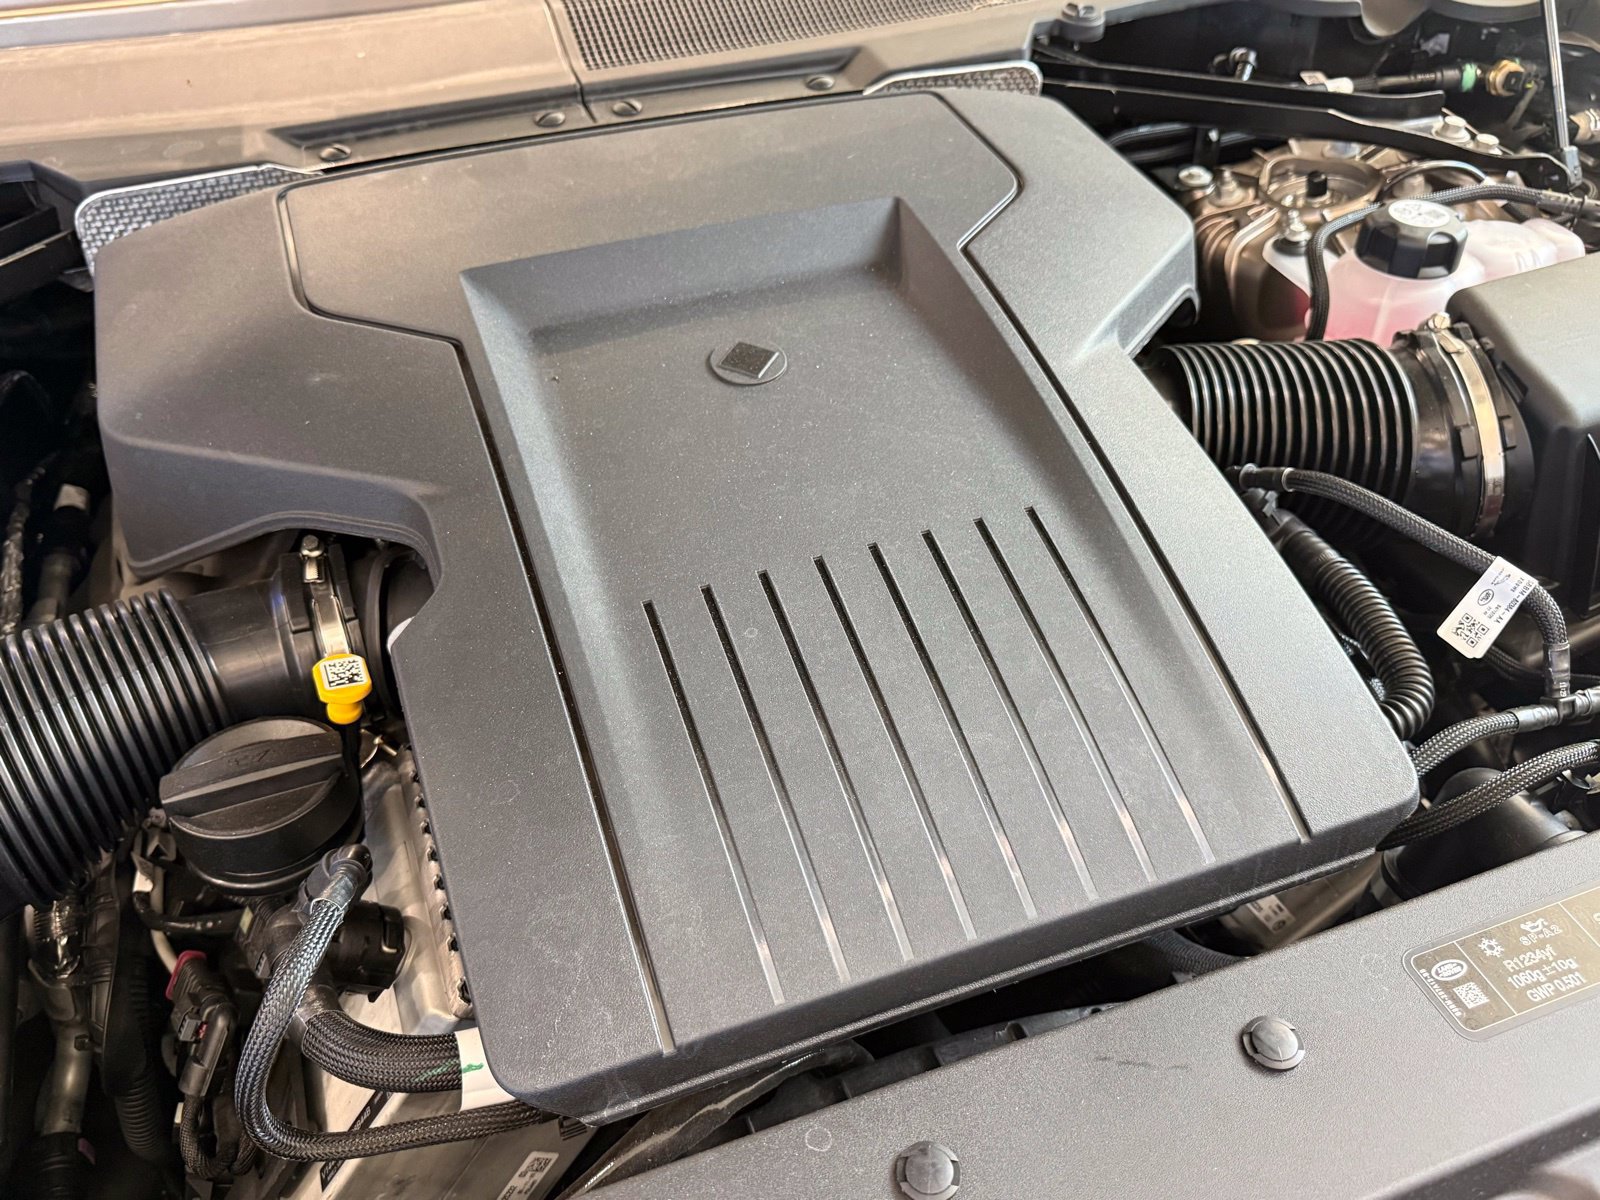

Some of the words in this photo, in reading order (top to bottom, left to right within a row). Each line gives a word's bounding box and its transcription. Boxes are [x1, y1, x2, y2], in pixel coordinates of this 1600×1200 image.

[1519, 924, 1563, 946] SP-A2
[1502, 943, 1557, 973] R1234yf
[1507, 969, 1547, 989] 1060g
[1541, 957, 1579, 976] ±10g
[1526, 981, 1557, 1002] GWP
[1552, 971, 1586, 992] 0.501
